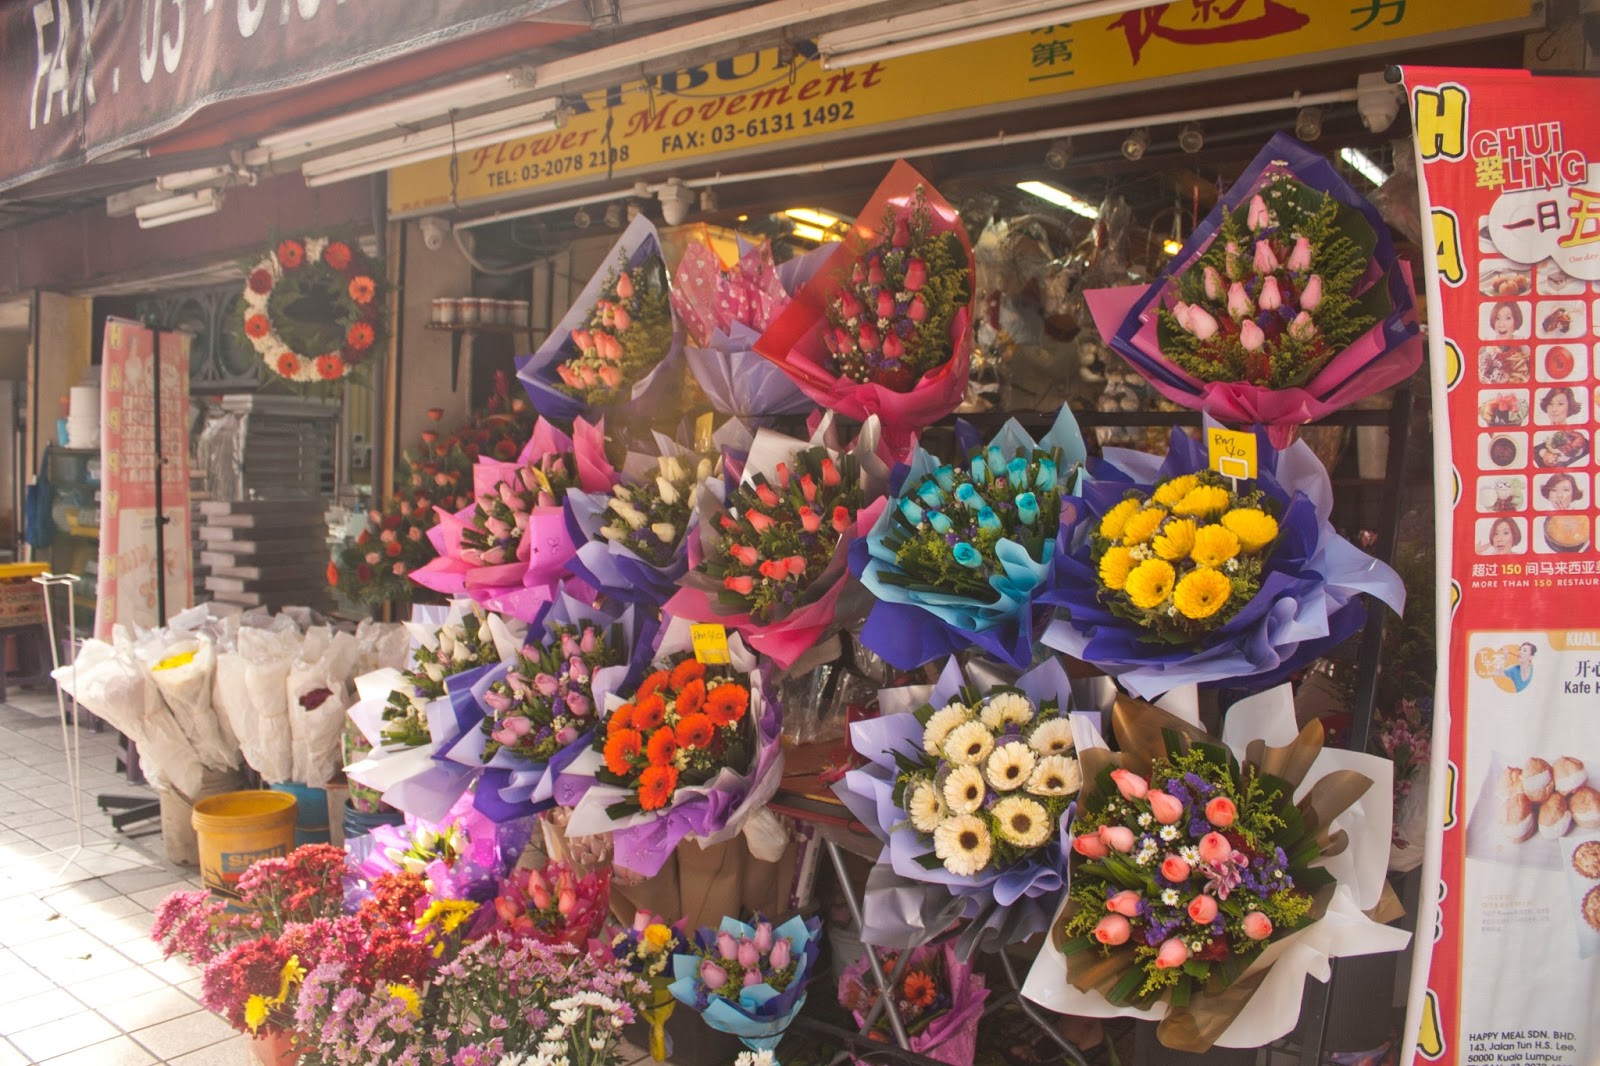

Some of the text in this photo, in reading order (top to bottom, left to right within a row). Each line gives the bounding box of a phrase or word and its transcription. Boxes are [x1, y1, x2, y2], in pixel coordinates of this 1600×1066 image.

[468, 129, 598, 175] Flower
[624, 62, 888, 138] Movement
[488, 171, 517, 188] TEL:
[521, 155, 582, 182] 03-2078
[661, 132, 705, 154] FAX:
[711, 115, 794, 145] 03-6131
[802, 100, 855, 127] 1492
[1472, 563, 1498, 578] 超过
[1501, 563, 1522, 576] 150
[1472, 580, 1498, 588] MORE
[1503, 580, 1529, 588] THAN
[1534, 579, 1552, 587] 150
[1564, 681, 1591, 694] Kafe
[1469, 1030, 1577, 1041] HAPPY MEAL SDN. BHD.
[1489, 1042, 1515, 1051] Jalan
[1517, 1041, 1532, 1050] Tun
[1535, 1041, 1553, 1050] H.S.
[1467, 1053, 1562, 1063] 50000 Kuala Lumpur
